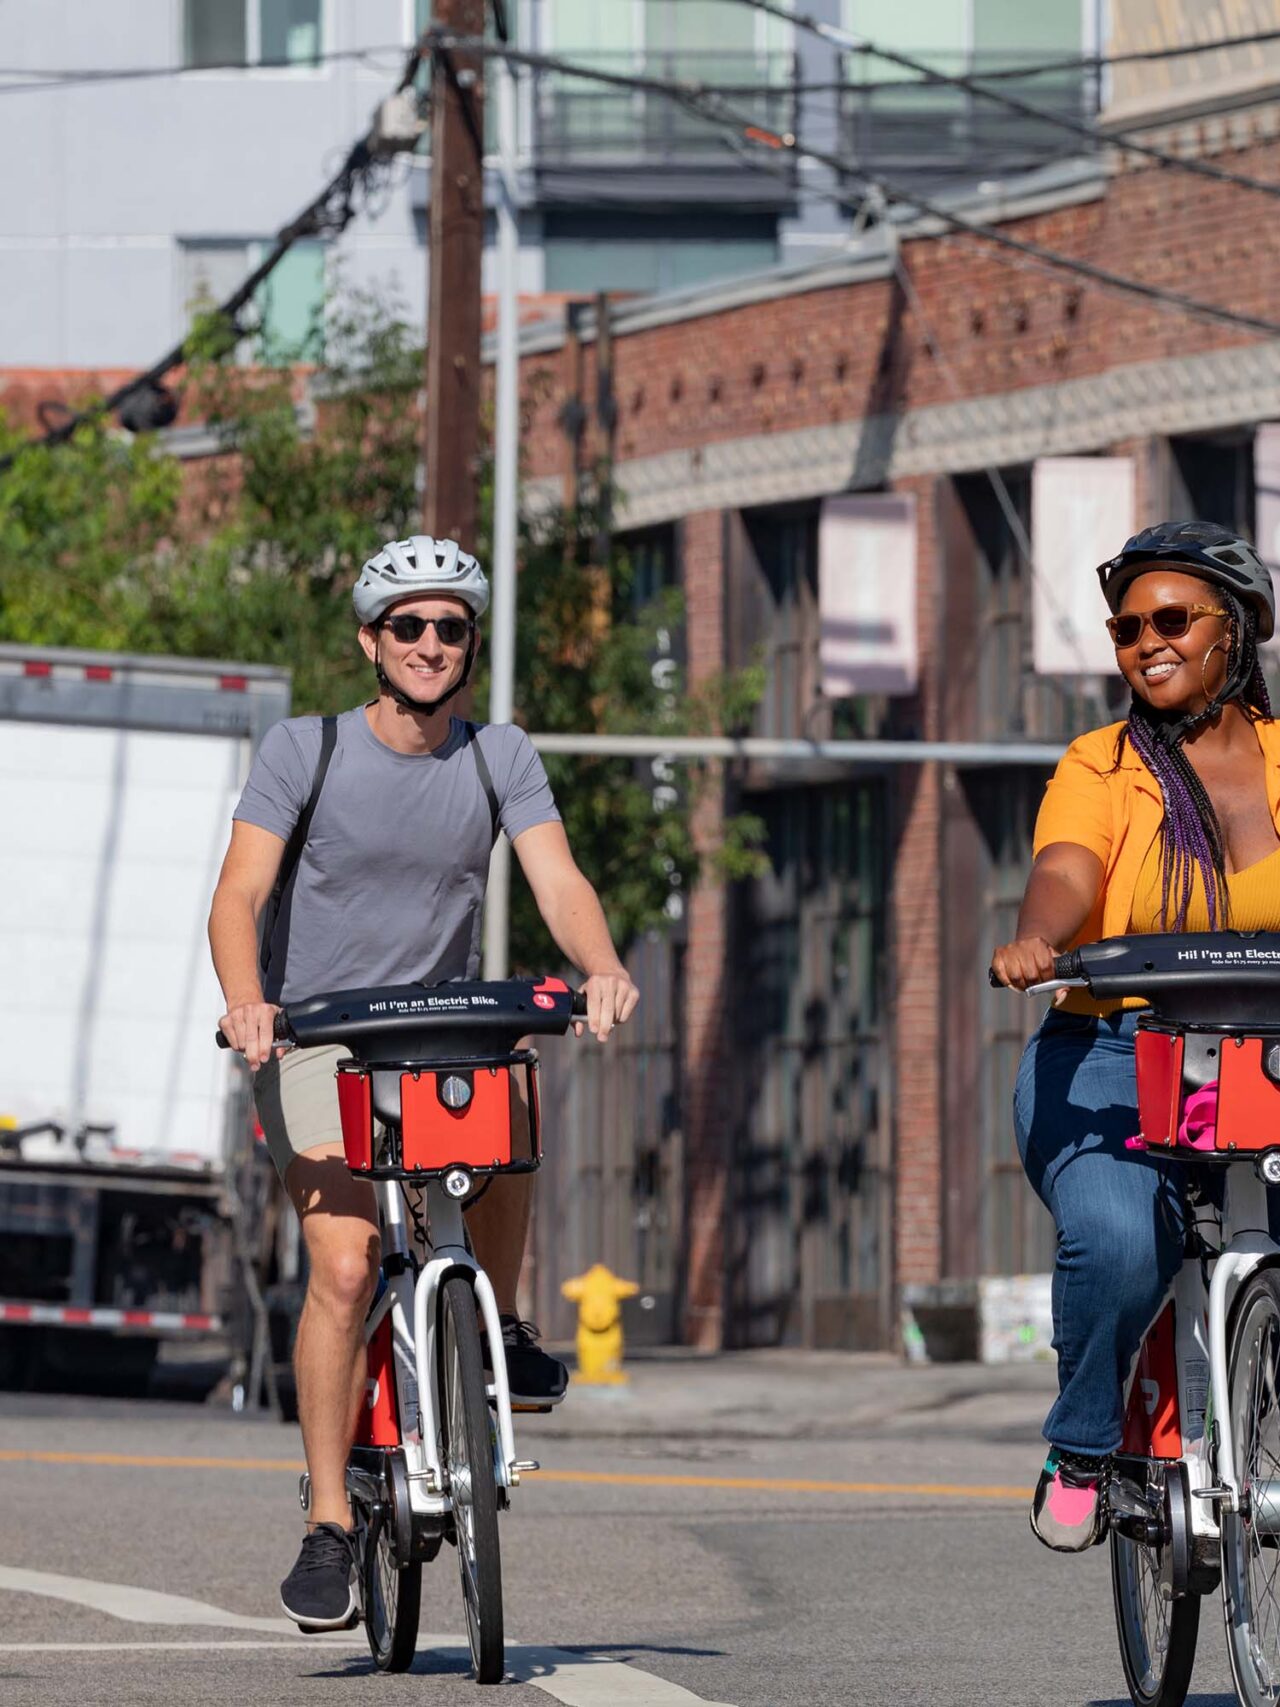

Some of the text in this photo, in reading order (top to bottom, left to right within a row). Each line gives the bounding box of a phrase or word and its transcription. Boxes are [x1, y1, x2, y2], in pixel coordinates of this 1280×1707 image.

[1178, 950, 1198, 960] Hi!
[1201, 950, 1222, 959] I'm
[369, 1001, 387, 1012] Hi!
[389, 1000, 408, 1009] I'm
[427, 996, 469, 1006] Electric
[471, 996, 498, 1005] Bike.
